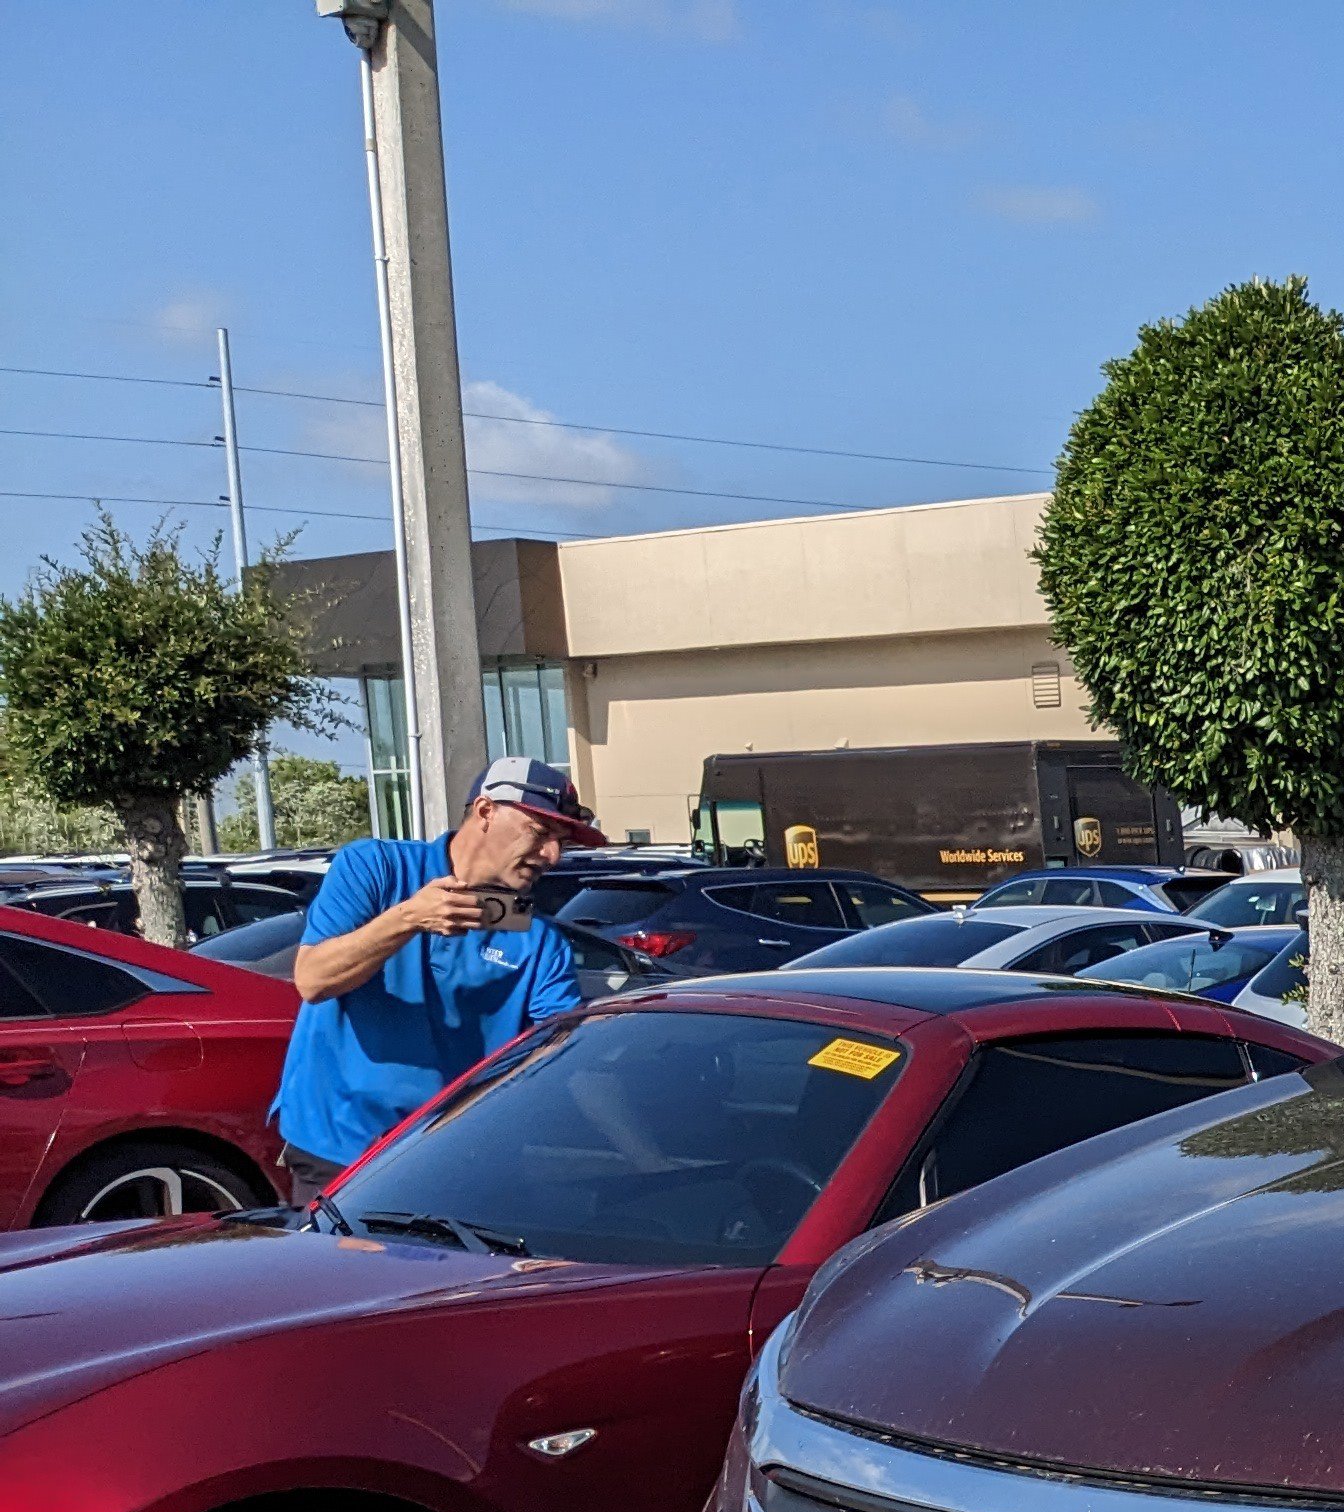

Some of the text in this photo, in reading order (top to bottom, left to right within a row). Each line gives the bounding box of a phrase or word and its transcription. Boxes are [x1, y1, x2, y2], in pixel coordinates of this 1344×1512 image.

[1077, 829, 1100, 851] ups
[788, 842, 817, 869] ups
[939, 848, 1024, 863] Worldwide Services
